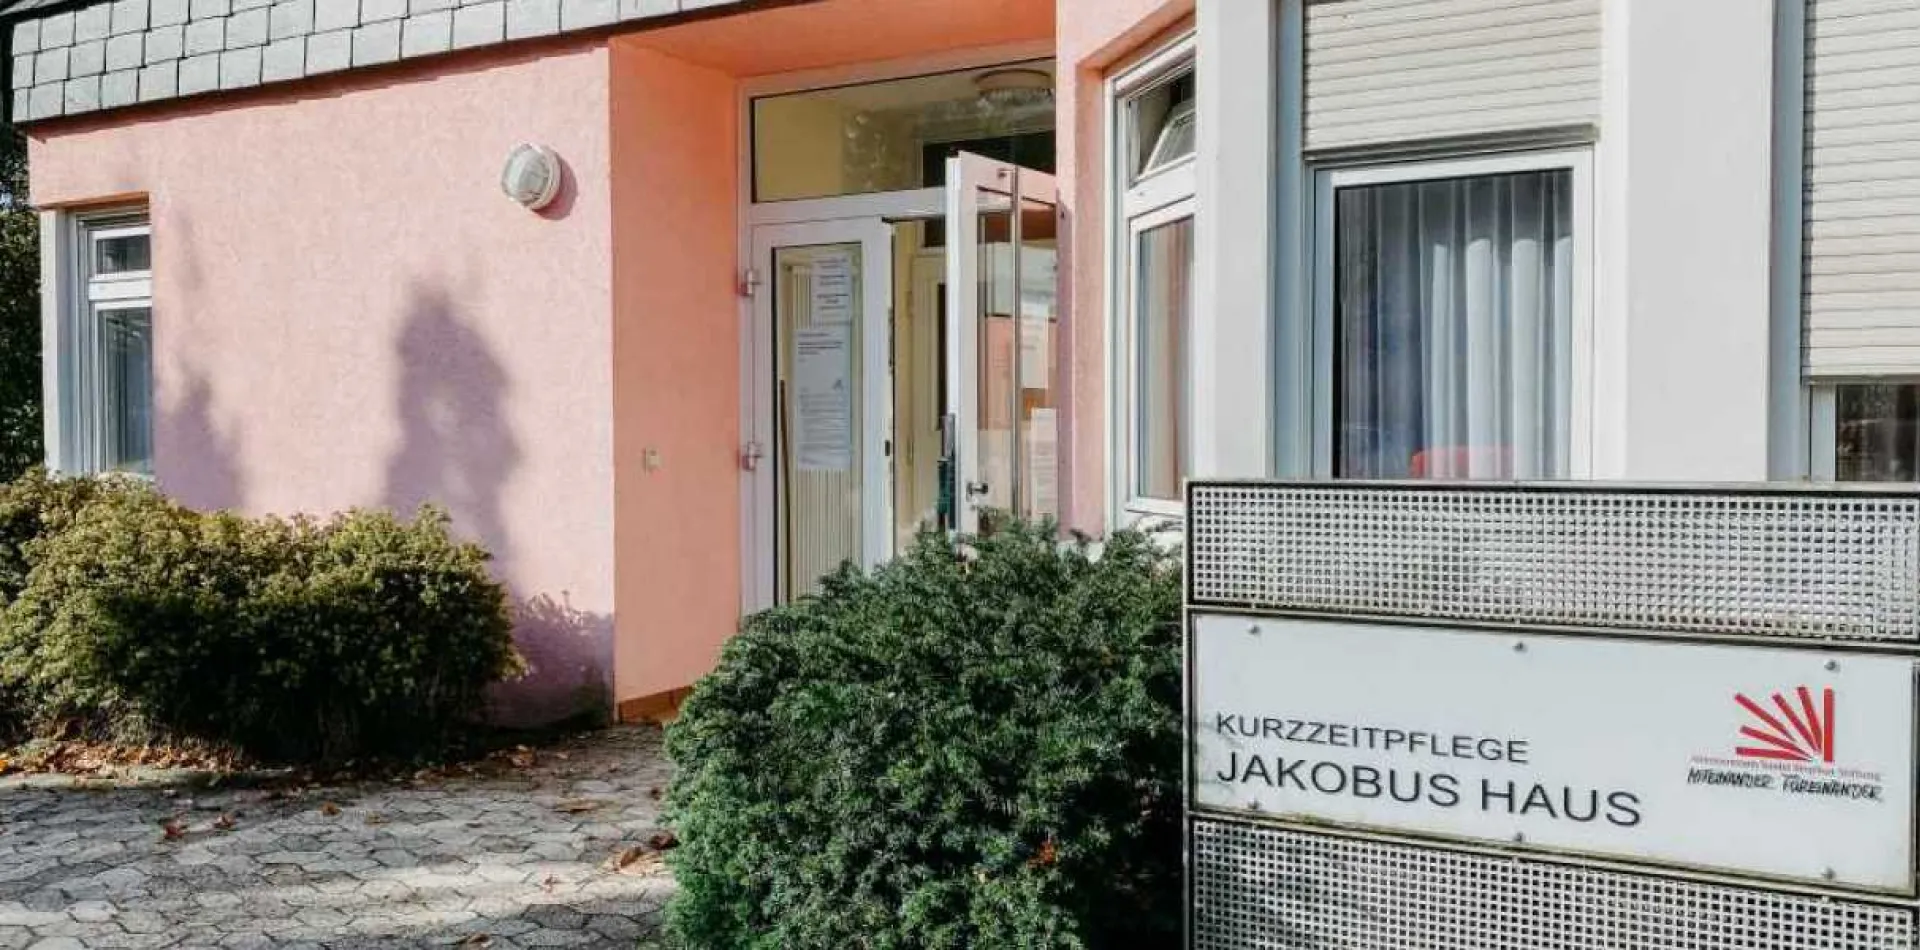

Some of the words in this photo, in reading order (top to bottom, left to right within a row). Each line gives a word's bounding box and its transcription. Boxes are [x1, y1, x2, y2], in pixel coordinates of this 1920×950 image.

[1216, 712, 1529, 764] KURZZEITPFLEGE
[1216, 751, 1461, 807] JAKOBUS
[1481, 778, 1641, 826] HAUS
